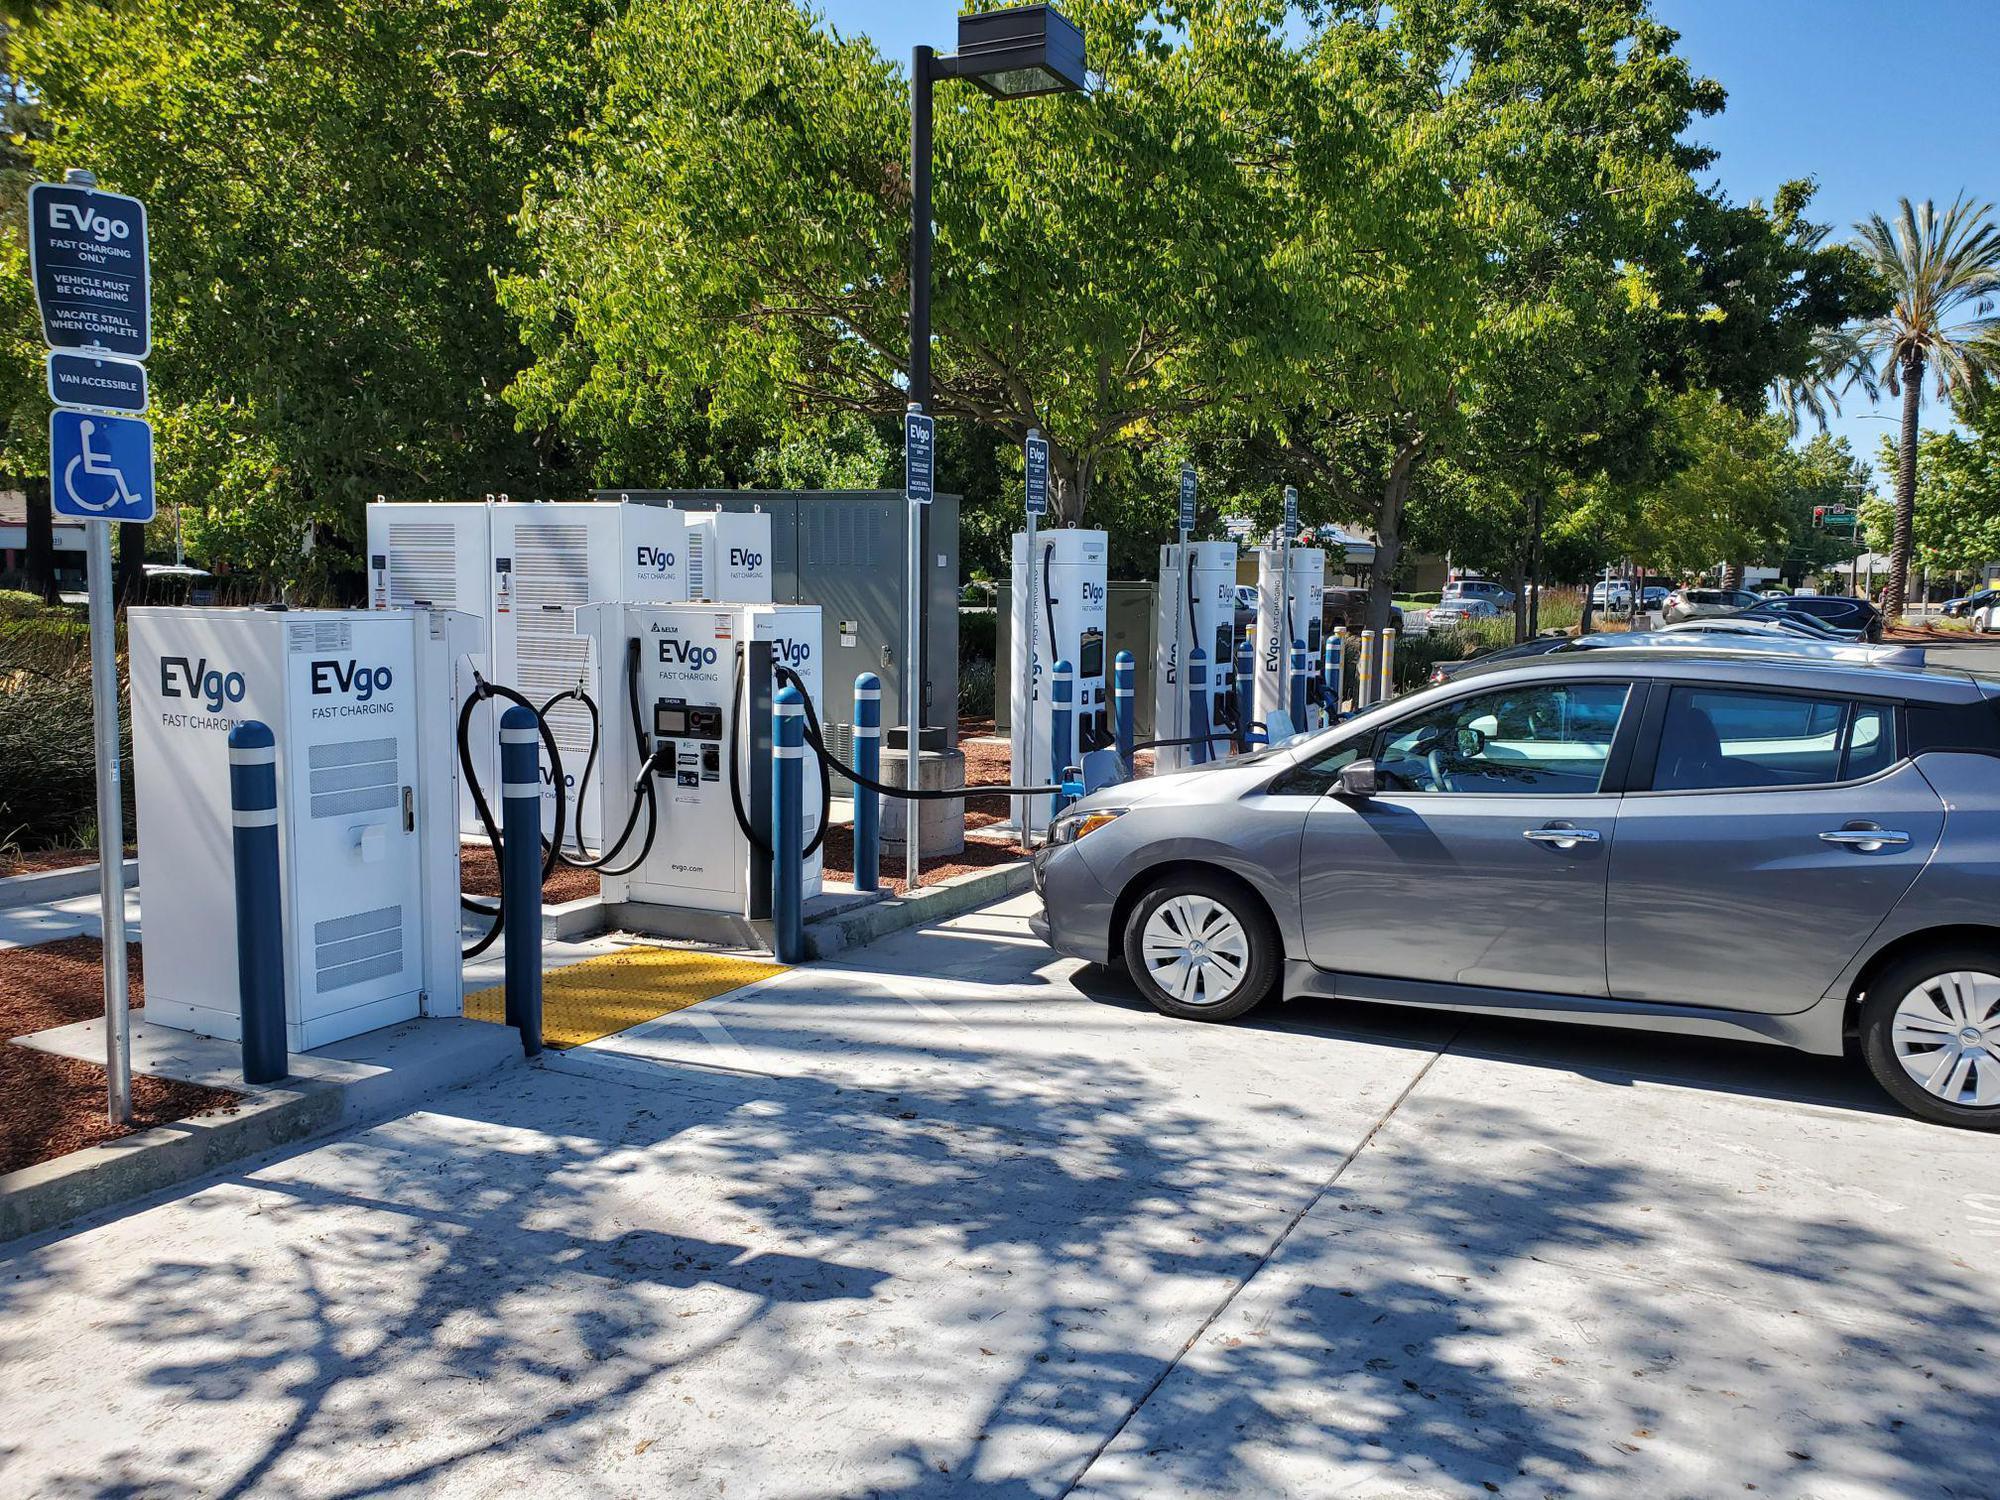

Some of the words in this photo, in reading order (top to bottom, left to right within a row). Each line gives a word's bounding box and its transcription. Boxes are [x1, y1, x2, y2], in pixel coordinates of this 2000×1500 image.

[49, 203, 129, 242] EVgo
[50, 239, 78, 250] FAST
[79, 242, 131, 259] CHARGING
[78, 252, 107, 264] ONLY
[54, 274, 101, 288] VEHICLE
[102, 280, 131, 293] MUST
[56, 285, 71, 295] BE
[73, 287, 129, 302] CHARGING
[56, 310, 98, 322] VACATE
[101, 314, 131, 327] STALL
[50, 320, 83, 331] WHEN
[84, 322, 138, 338] COMPLETE
[59, 373, 80, 384] VAN
[81, 376, 137, 392] ACCESSIBLE
[910, 424, 930, 443] EVgo
[1029, 447, 1046, 464] EVgo
[637, 546, 676, 572] EVgo
[730, 548, 763, 571] EVgo
[1082, 582, 1104, 604] EVgo
[659, 639, 718, 671] EVgo
[772, 638, 810, 667] EVgo
[1266, 637, 1280, 672] EVgo
[160, 656, 246, 713] EVgo
[311, 659, 393, 701] EVgo
[659, 671, 678, 680] FAST
[678, 672, 718, 682] CHARGING
[162, 713, 188, 727] FAST
[312, 706, 338, 719] FAST
[339, 702, 394, 717] CHARGING
[671, 863, 704, 873] evgo.com
